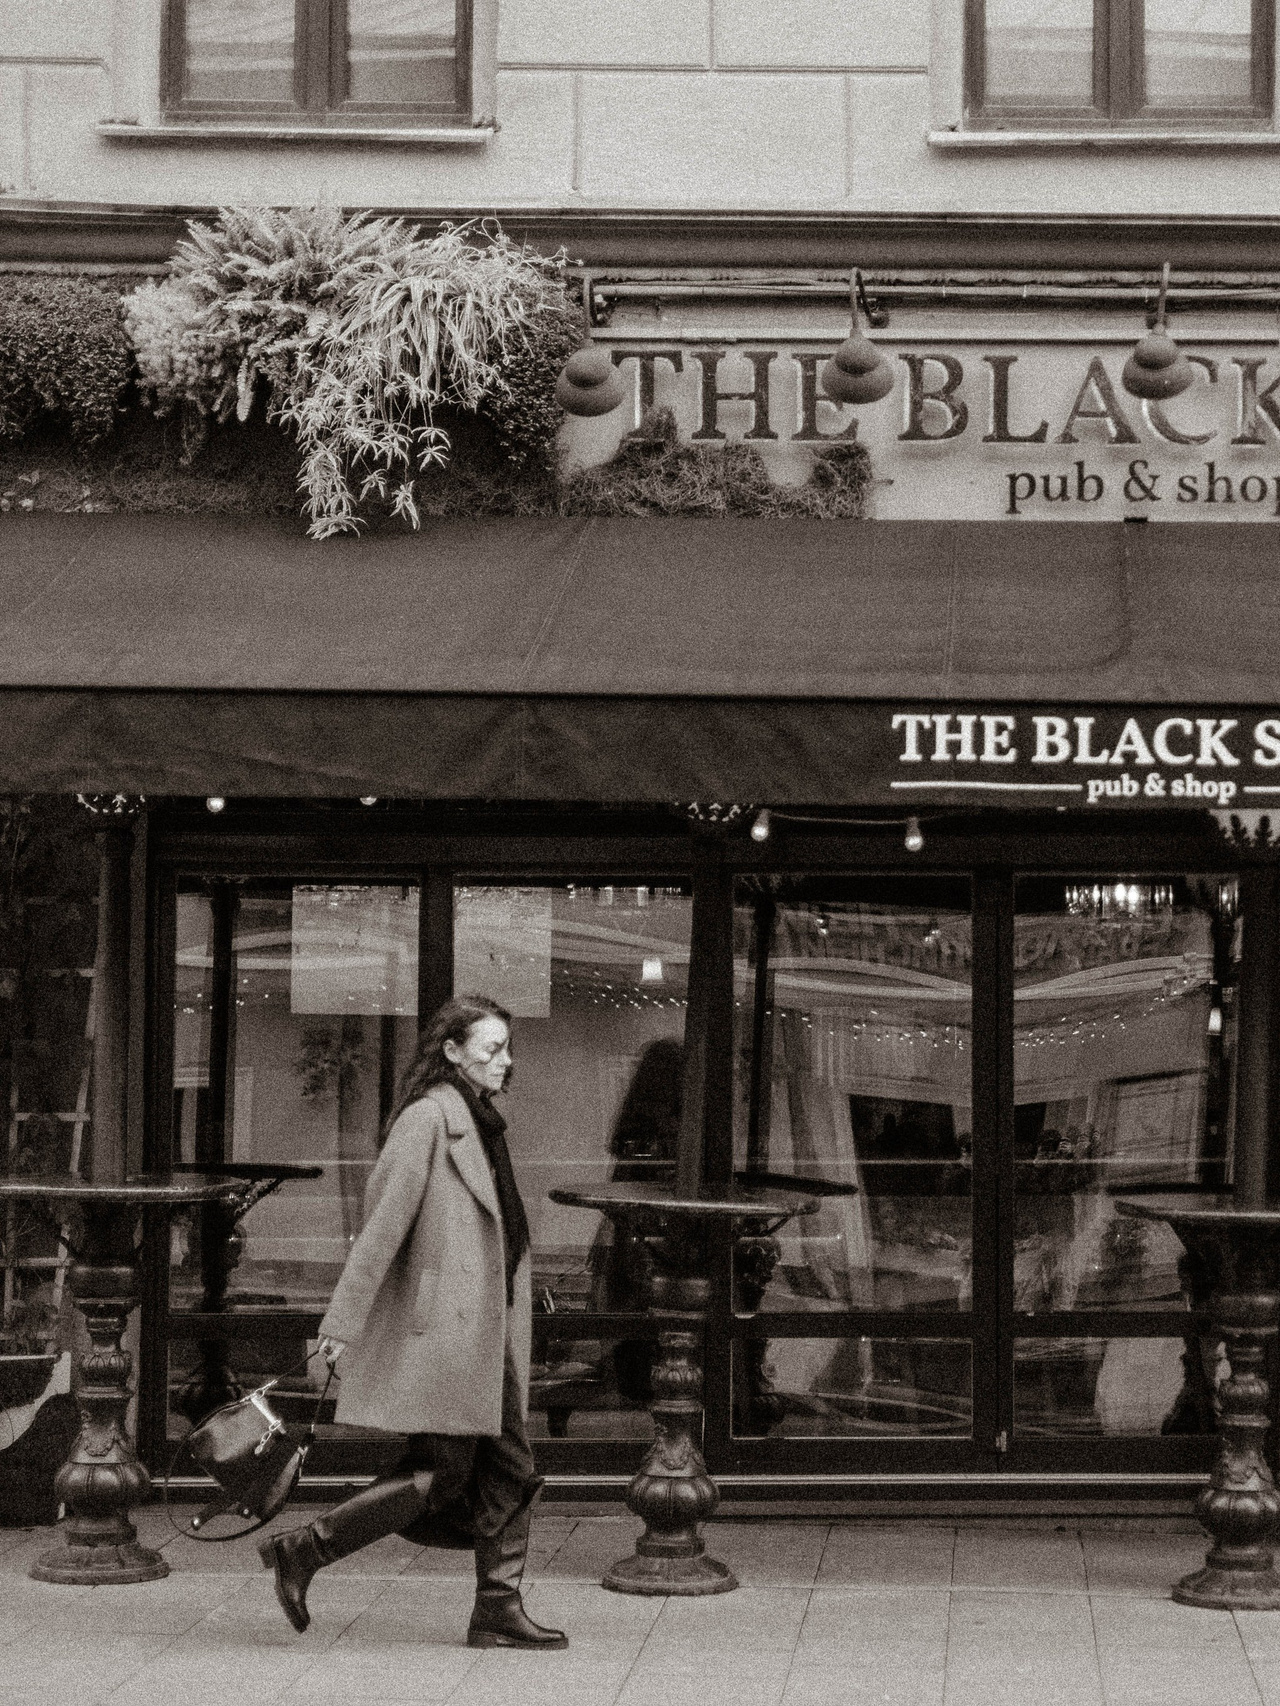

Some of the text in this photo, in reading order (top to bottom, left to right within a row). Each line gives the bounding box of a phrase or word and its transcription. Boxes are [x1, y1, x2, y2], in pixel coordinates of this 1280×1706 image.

[611, 349, 859, 441] THE
[1005, 461, 1104, 515] pub
[1122, 459, 1163, 503] &
[891, 713, 1018, 763] THE
[1031, 715, 1241, 767] BLACK
[1087, 772, 1238, 805] pub & shop
